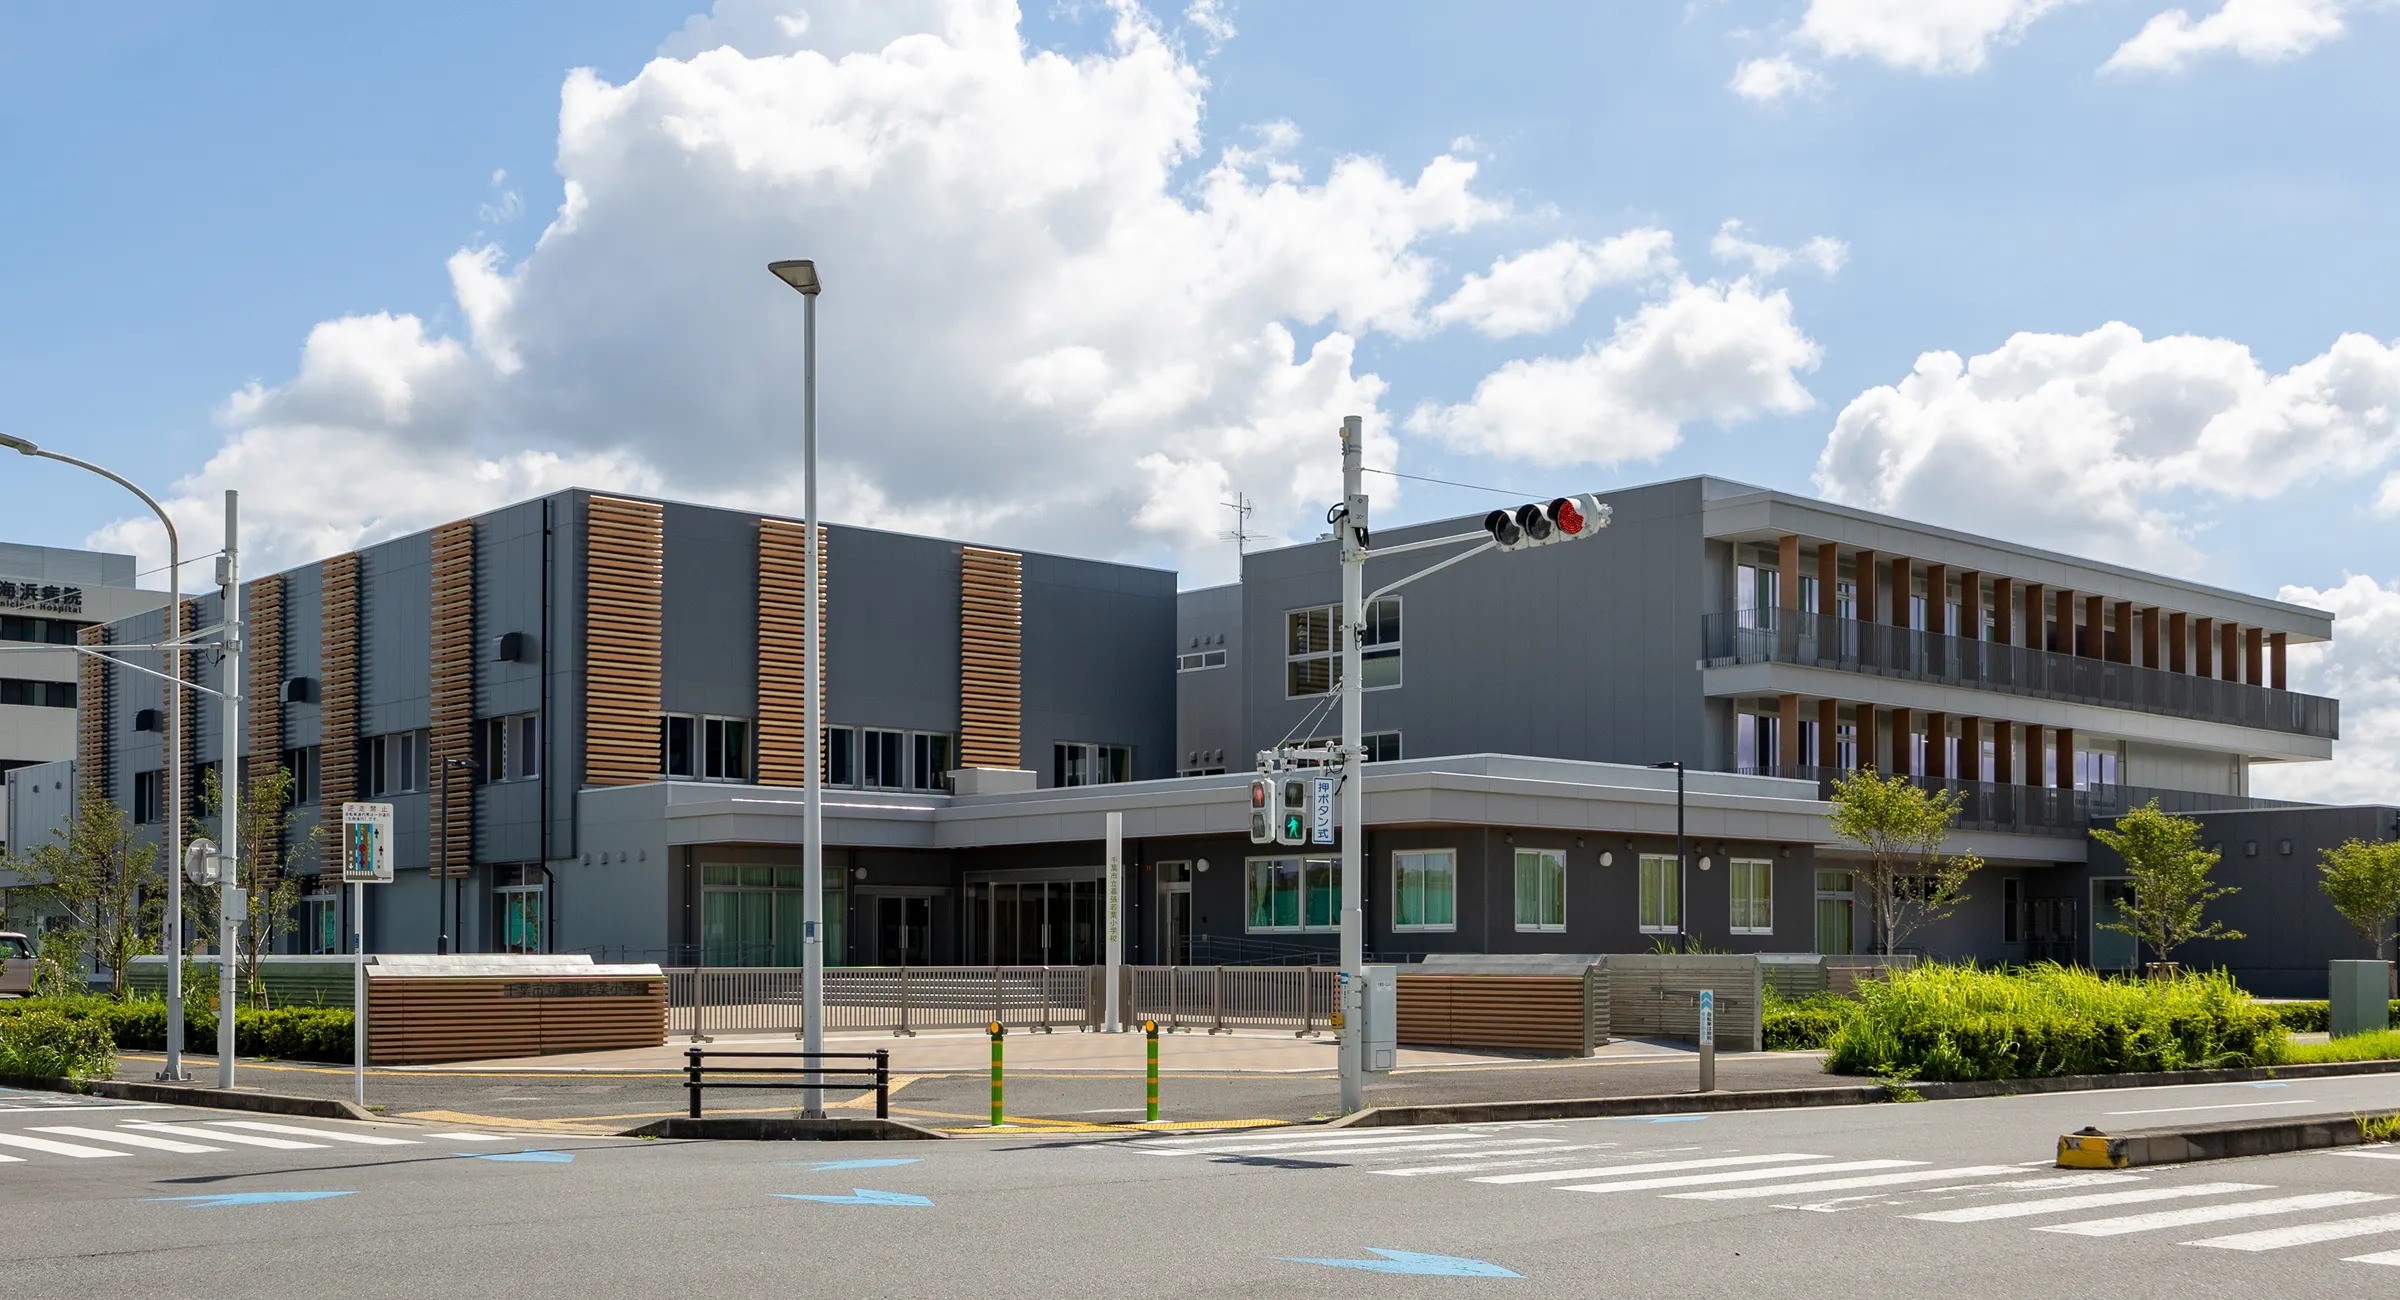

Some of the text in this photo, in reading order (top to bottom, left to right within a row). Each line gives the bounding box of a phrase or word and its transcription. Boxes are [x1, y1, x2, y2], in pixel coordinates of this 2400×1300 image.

[0, 581, 82, 606] 海浜病院
[39, 603, 82, 613] Hospital
[1318, 782, 1329, 839] 押ボタン式
